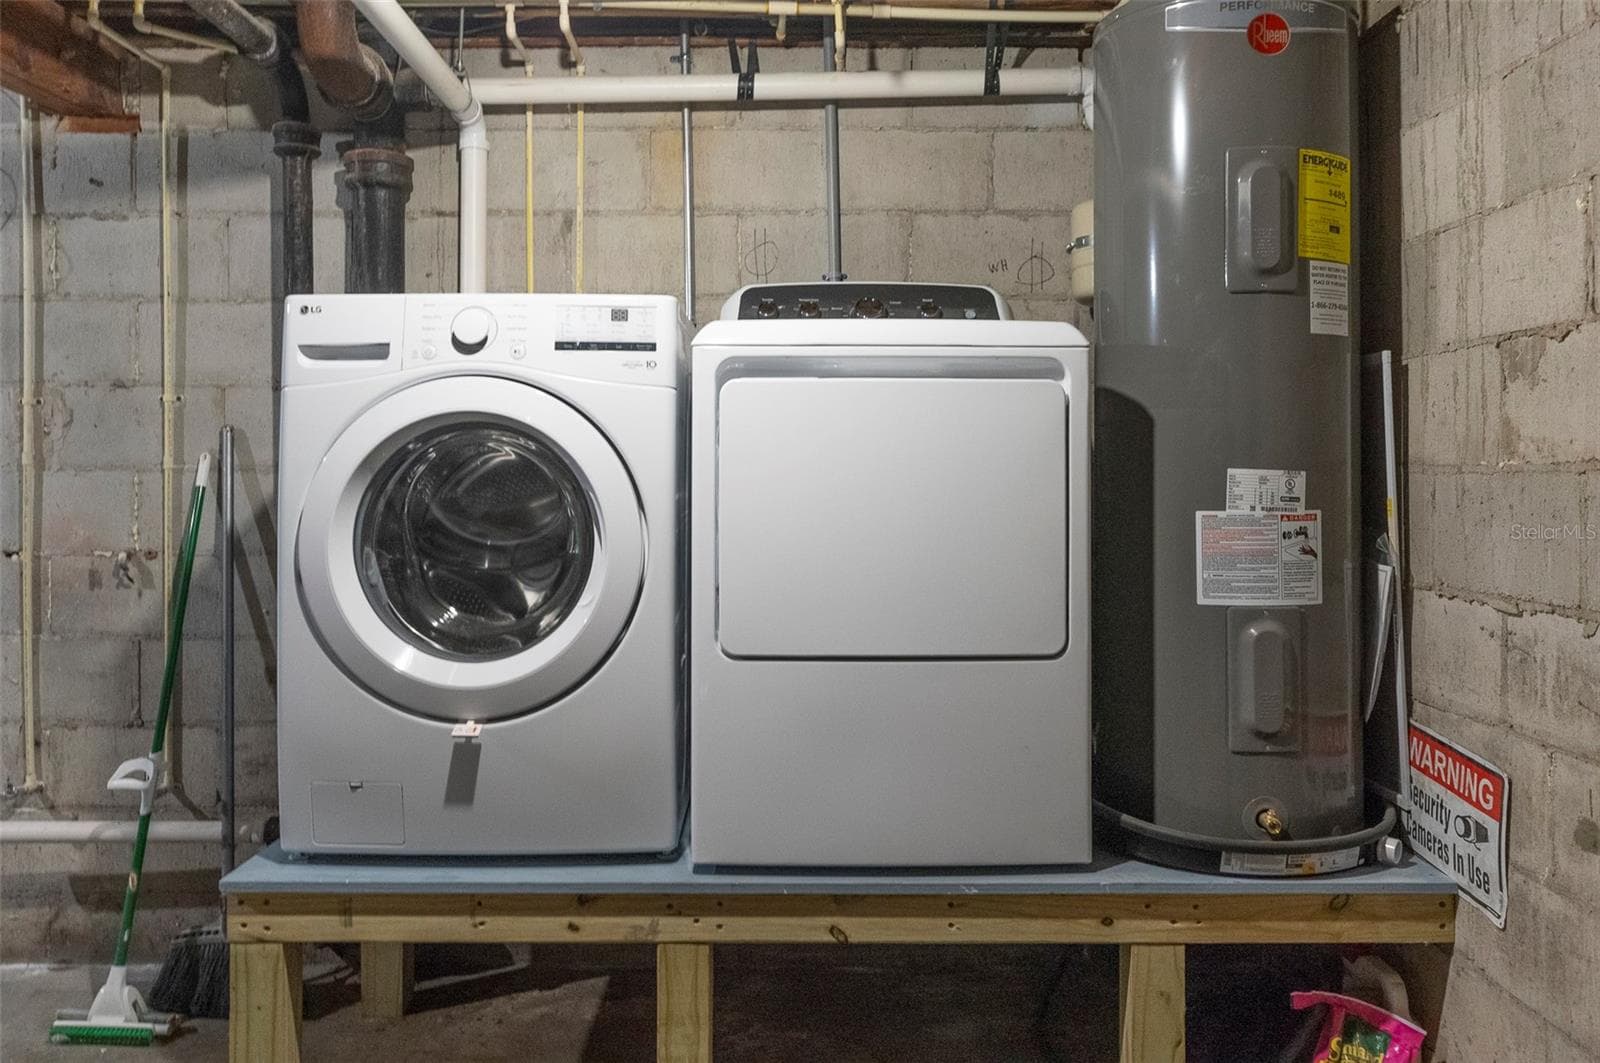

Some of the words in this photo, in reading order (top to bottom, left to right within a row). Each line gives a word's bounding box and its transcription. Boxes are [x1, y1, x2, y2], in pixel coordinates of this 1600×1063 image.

[1220, 0, 1316, 13] PERFOANCE
[1252, 14, 1289, 49] Rheem
[1410, 736, 1494, 811] WARNING
[1411, 776, 1451, 834] ecurity
[1407, 809, 1449, 865] Cameras
[1453, 843, 1465, 876] In
[1468, 853, 1490, 895] Use
